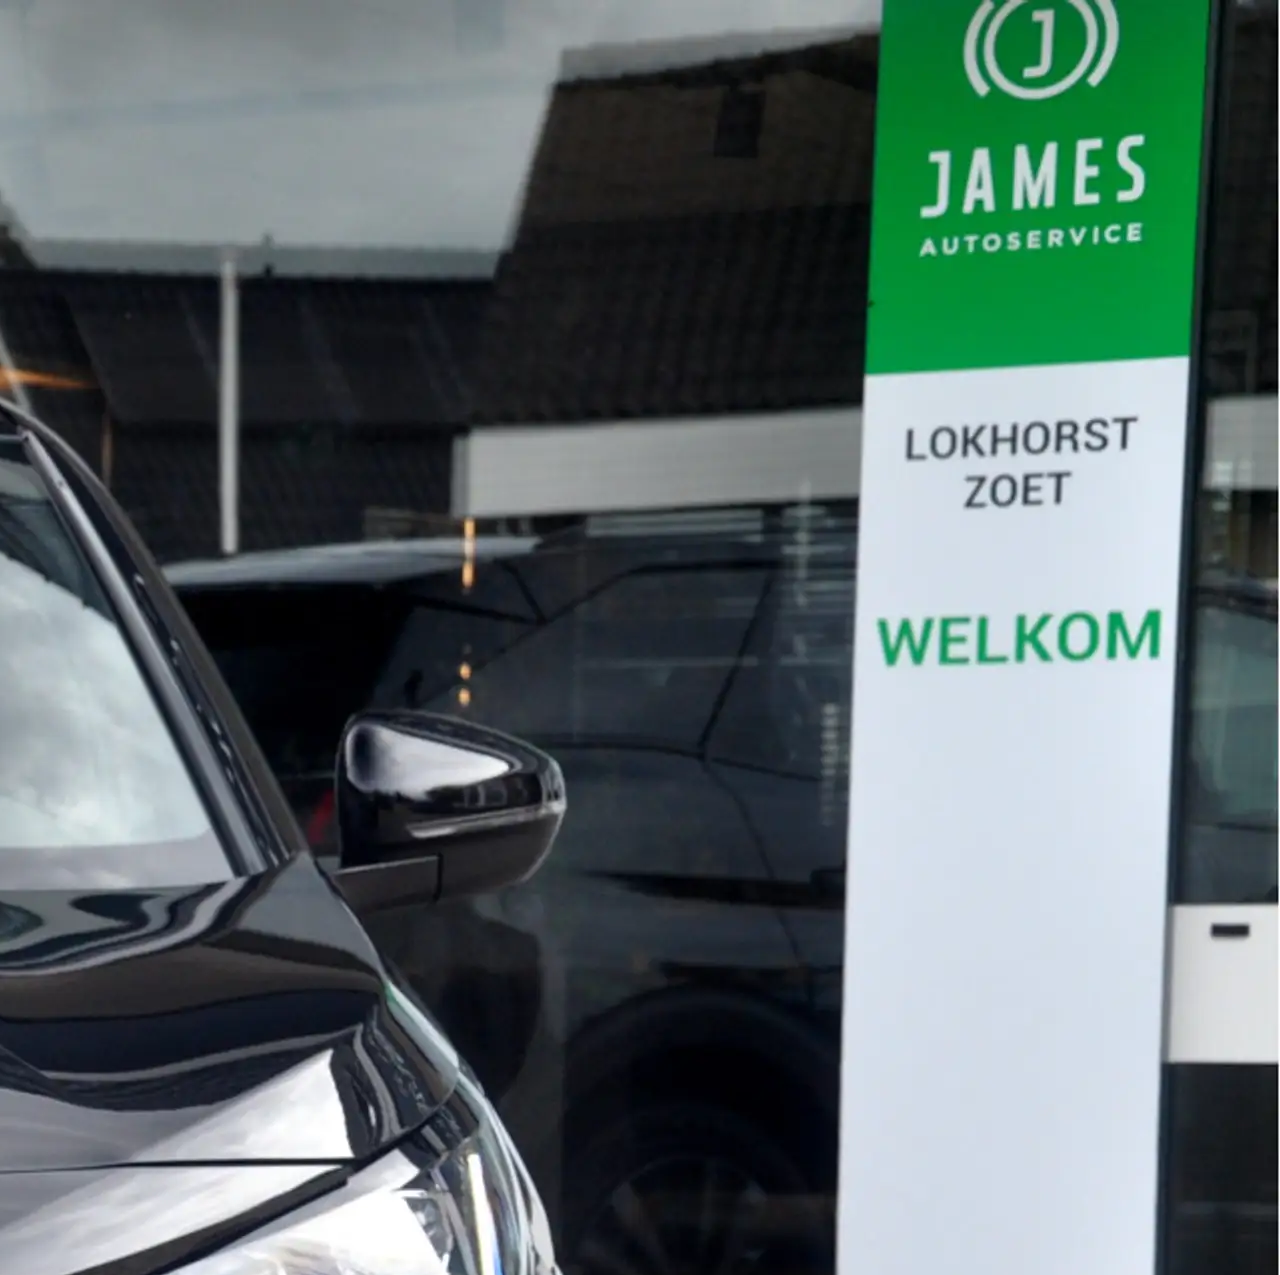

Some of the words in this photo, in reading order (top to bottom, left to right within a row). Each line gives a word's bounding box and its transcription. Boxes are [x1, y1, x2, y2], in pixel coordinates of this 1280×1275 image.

[919, 134, 1145, 218] JAMES
[919, 222, 1143, 257] AUTOSERVICE
[905, 416, 1138, 461] LOKHORST
[963, 471, 1072, 509] ZOET
[877, 609, 1162, 667] WELKOM
